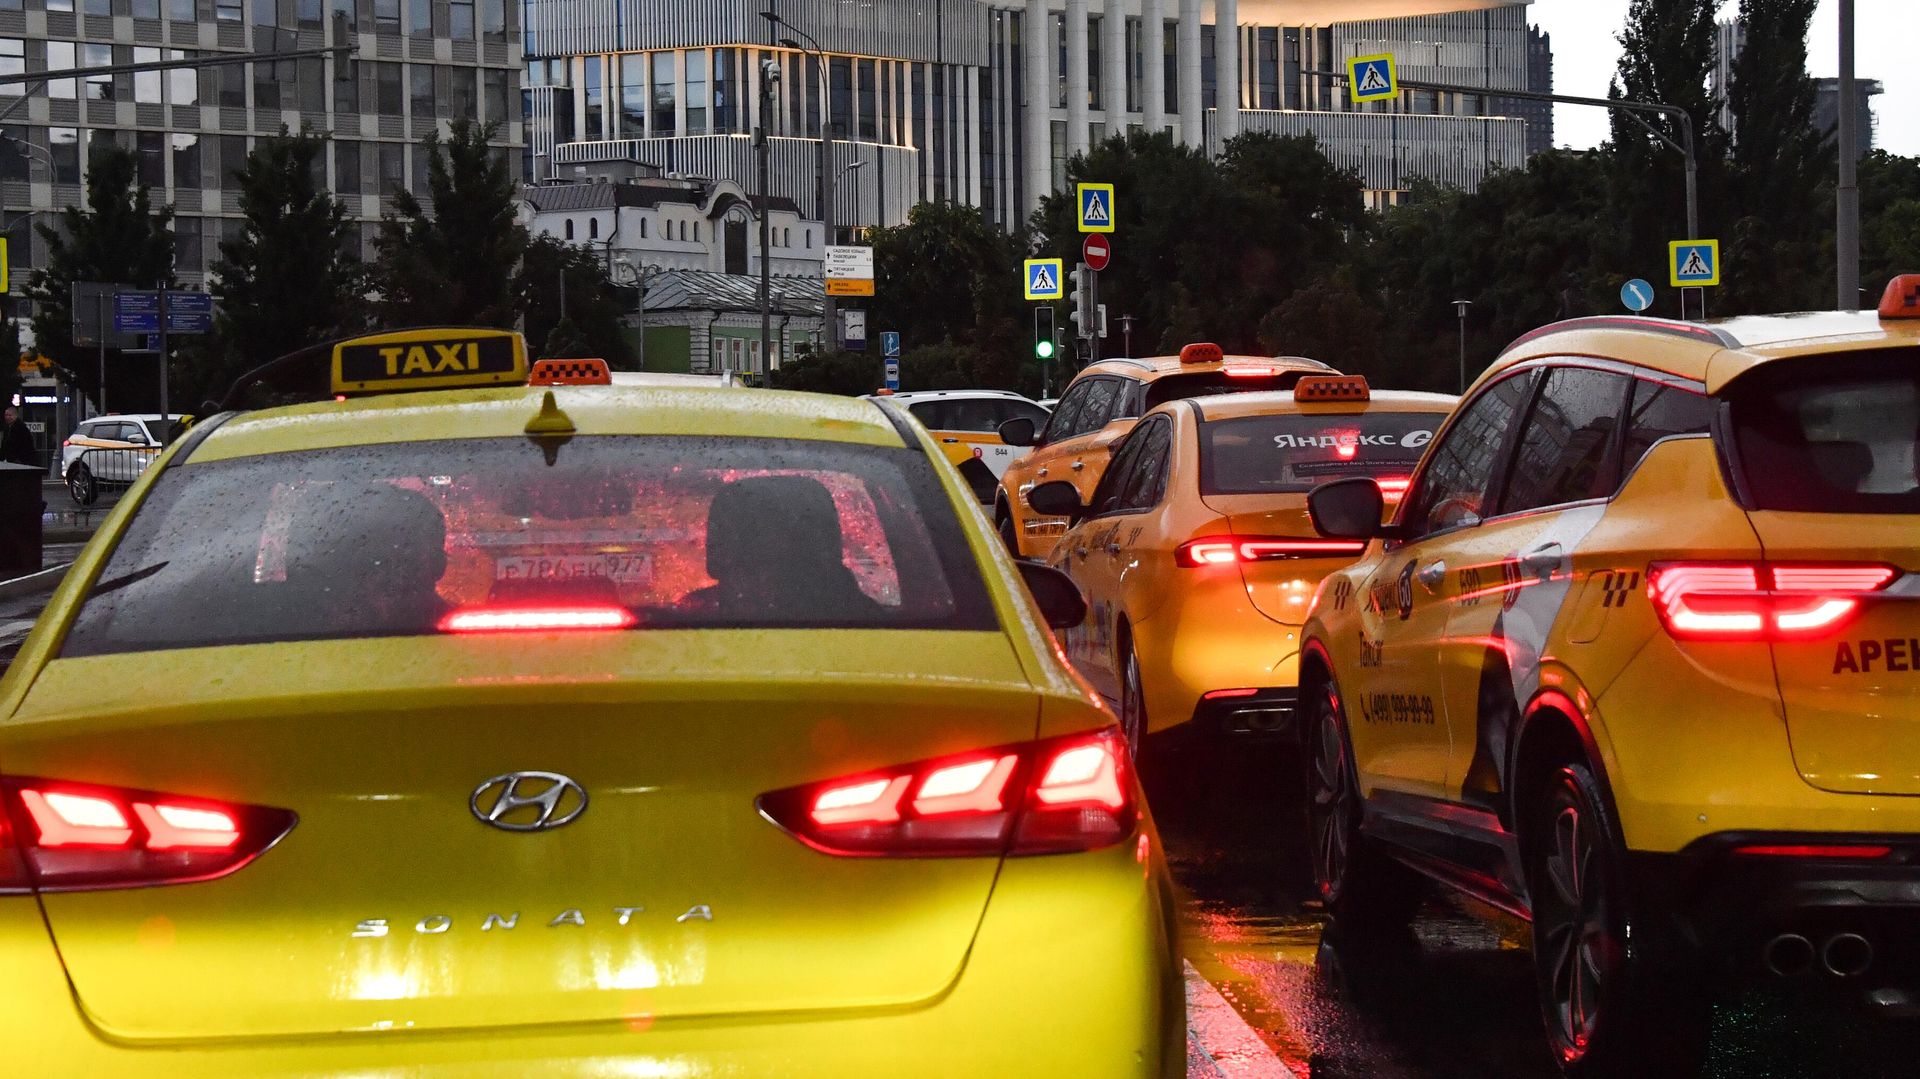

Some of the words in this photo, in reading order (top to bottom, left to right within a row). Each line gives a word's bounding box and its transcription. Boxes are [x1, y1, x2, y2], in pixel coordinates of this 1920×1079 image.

[379, 342, 480, 375] TAXI
[27, 423, 42, 431] ТОП
[1273, 433, 1397, 449] Яндекс
[1401, 430, 1434, 448] G
[995, 448, 1008, 456] 844
[608, 555, 645, 574] 977
[1359, 631, 1384, 667] Такси
[1368, 691, 1392, 725] (499)
[351, 904, 713, 938] SONATA
